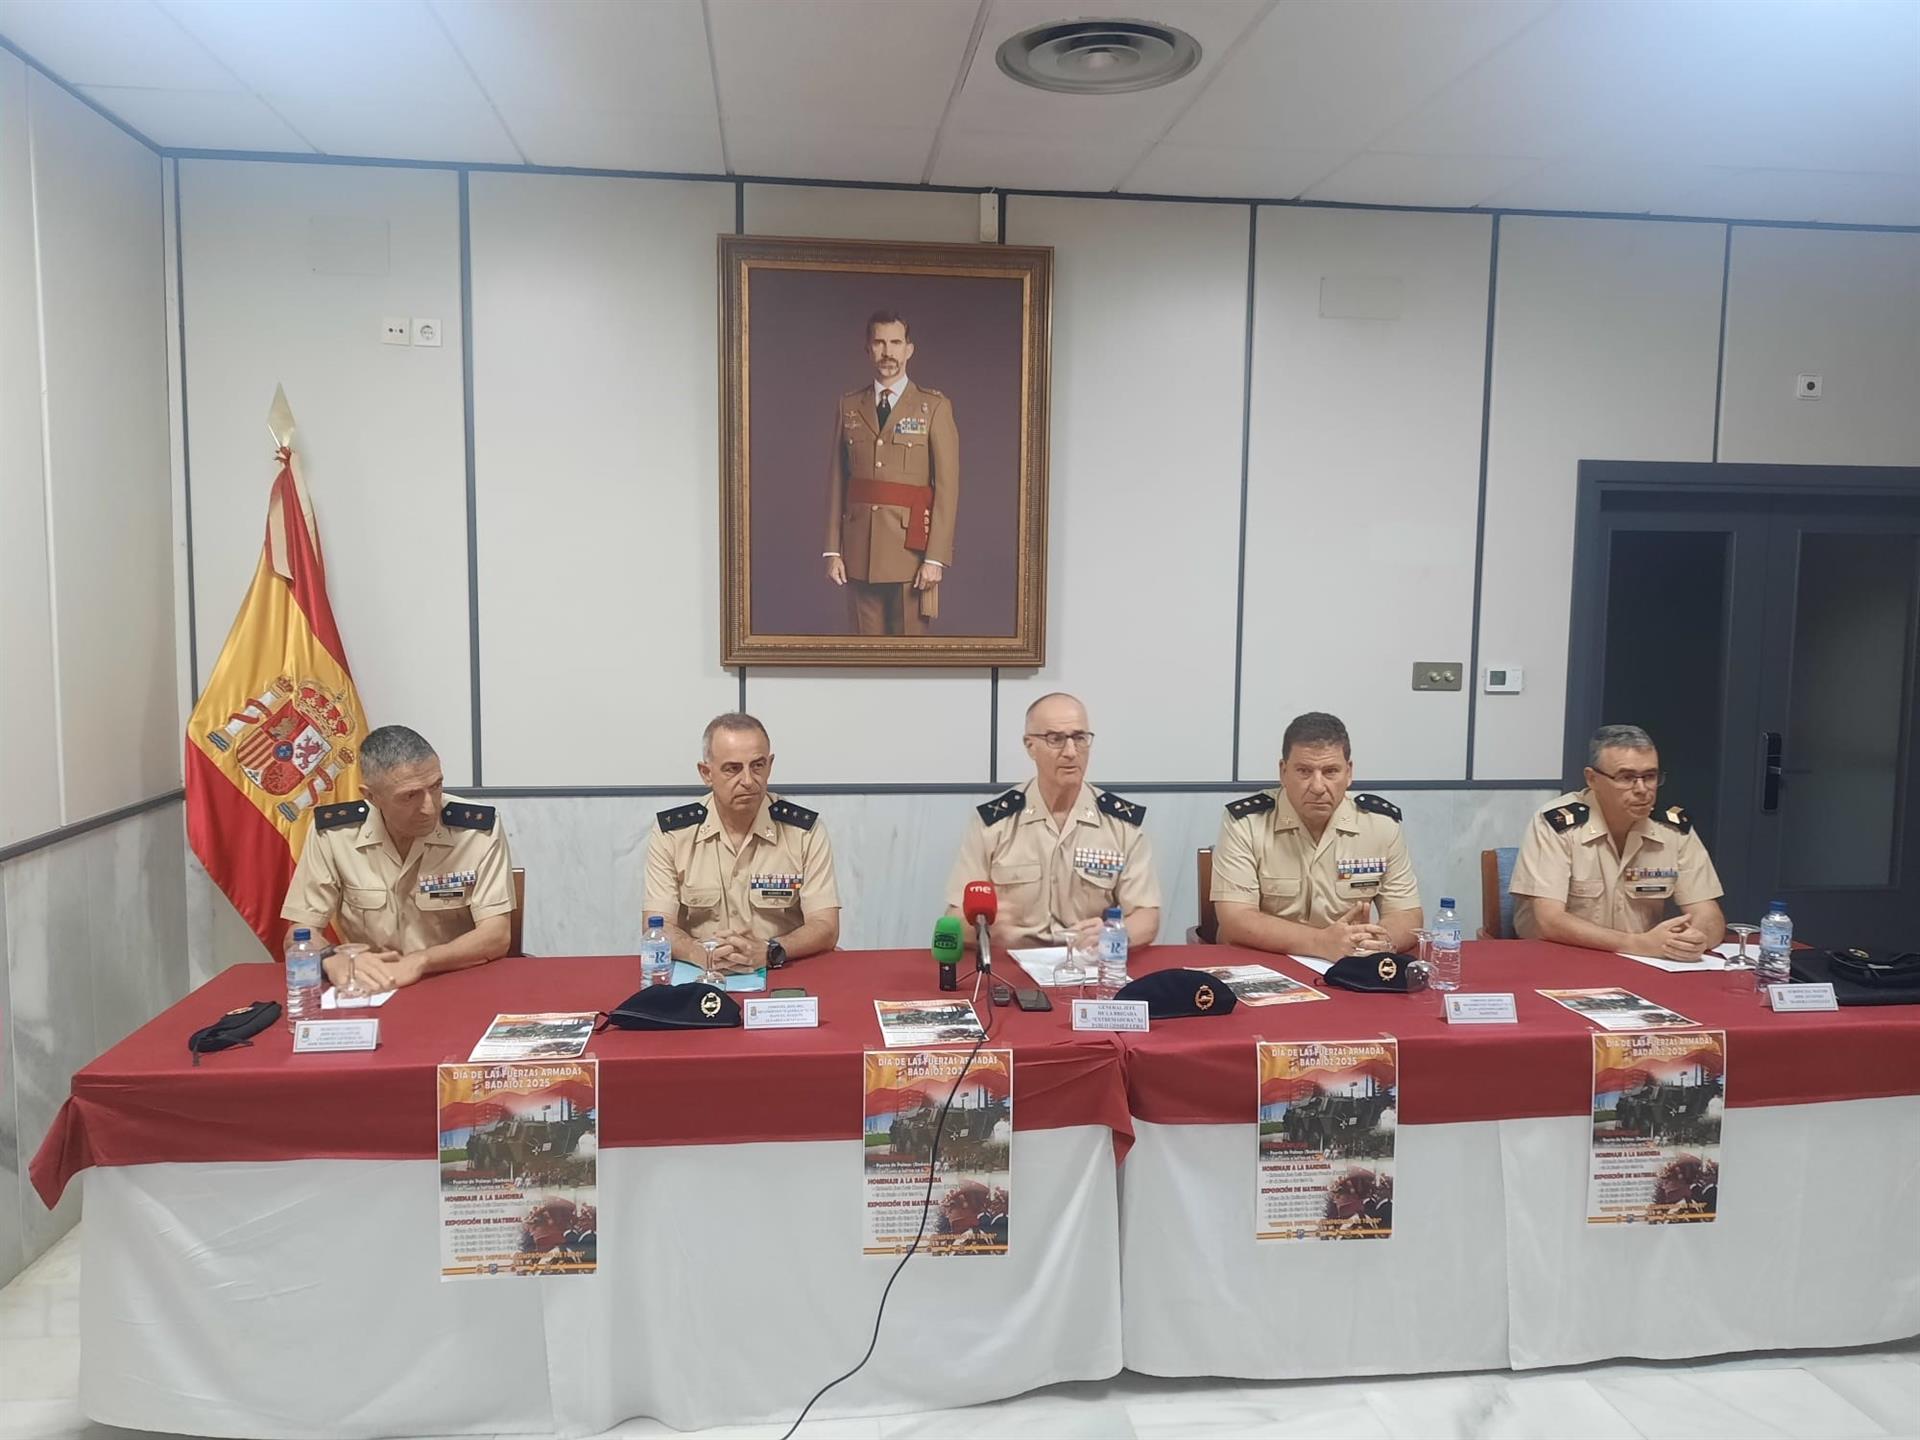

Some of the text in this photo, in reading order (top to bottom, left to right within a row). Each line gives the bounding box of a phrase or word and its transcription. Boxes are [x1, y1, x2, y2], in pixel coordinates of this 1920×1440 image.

[1621, 1039, 1631, 1047] DE
[1288, 1048, 1298, 1056] DE
[1300, 1048, 1313, 1056] LAS
[1314, 1047, 1347, 1056] FUERZAS
[1349, 1046, 1384, 1056] ARMADAS
[1666, 1048, 1687, 1056] 2025
[895, 1058, 906, 1066] DE
[908, 1057, 921, 1066] LAS
[921, 1056, 958, 1066] FUERZAS
[1336, 1057, 1358, 1066] 2025
[470, 1070, 483, 1079] DE
[484, 1069, 500, 1078] LAS
[500, 1068, 539, 1078] FUERZAS
[541, 1066, 582, 1077] ARMADAS
[946, 1066, 969, 1076] 202
[527, 1078, 550, 1088] 2025
